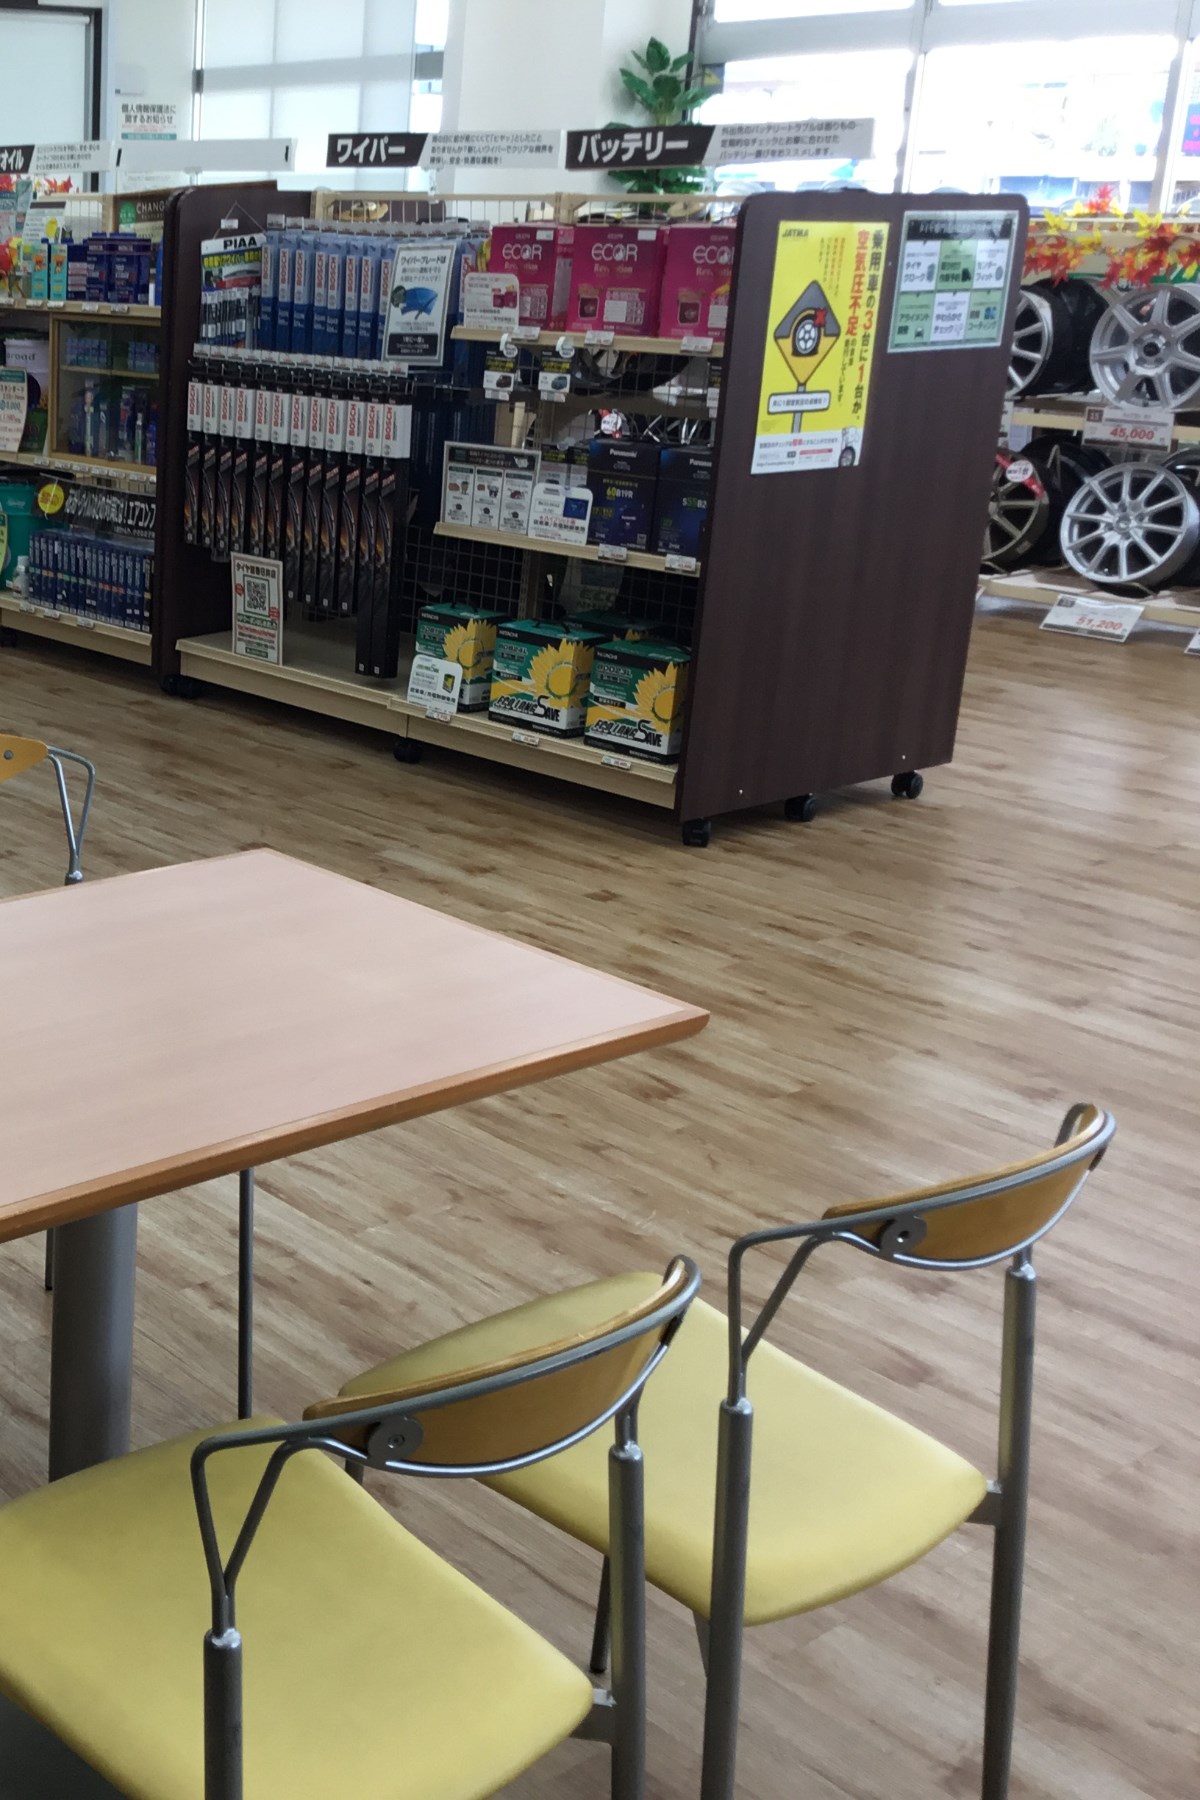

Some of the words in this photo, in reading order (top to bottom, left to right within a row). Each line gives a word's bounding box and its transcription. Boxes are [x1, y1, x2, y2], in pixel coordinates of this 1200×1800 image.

[336, 136, 405, 163] ワイパー
[577, 130, 689, 163] バッテリー
[223, 236, 258, 250] PIAA
[782, 229, 809, 238] JATMA
[401, 255, 447, 265] ワイパーブレードは
[311, 399, 319, 432] BOSCH
[328, 401, 336, 434] BOSCH
[348, 403, 356, 436] BOSCH
[384, 406, 392, 440] BOSCH
[1109, 427, 1154, 440] 45,000
[609, 448, 638, 459] Panasonic
[1075, 616, 1122, 630] 51,200
[537, 695, 561, 722] SAVE
[635, 719, 663, 748] SAVE
